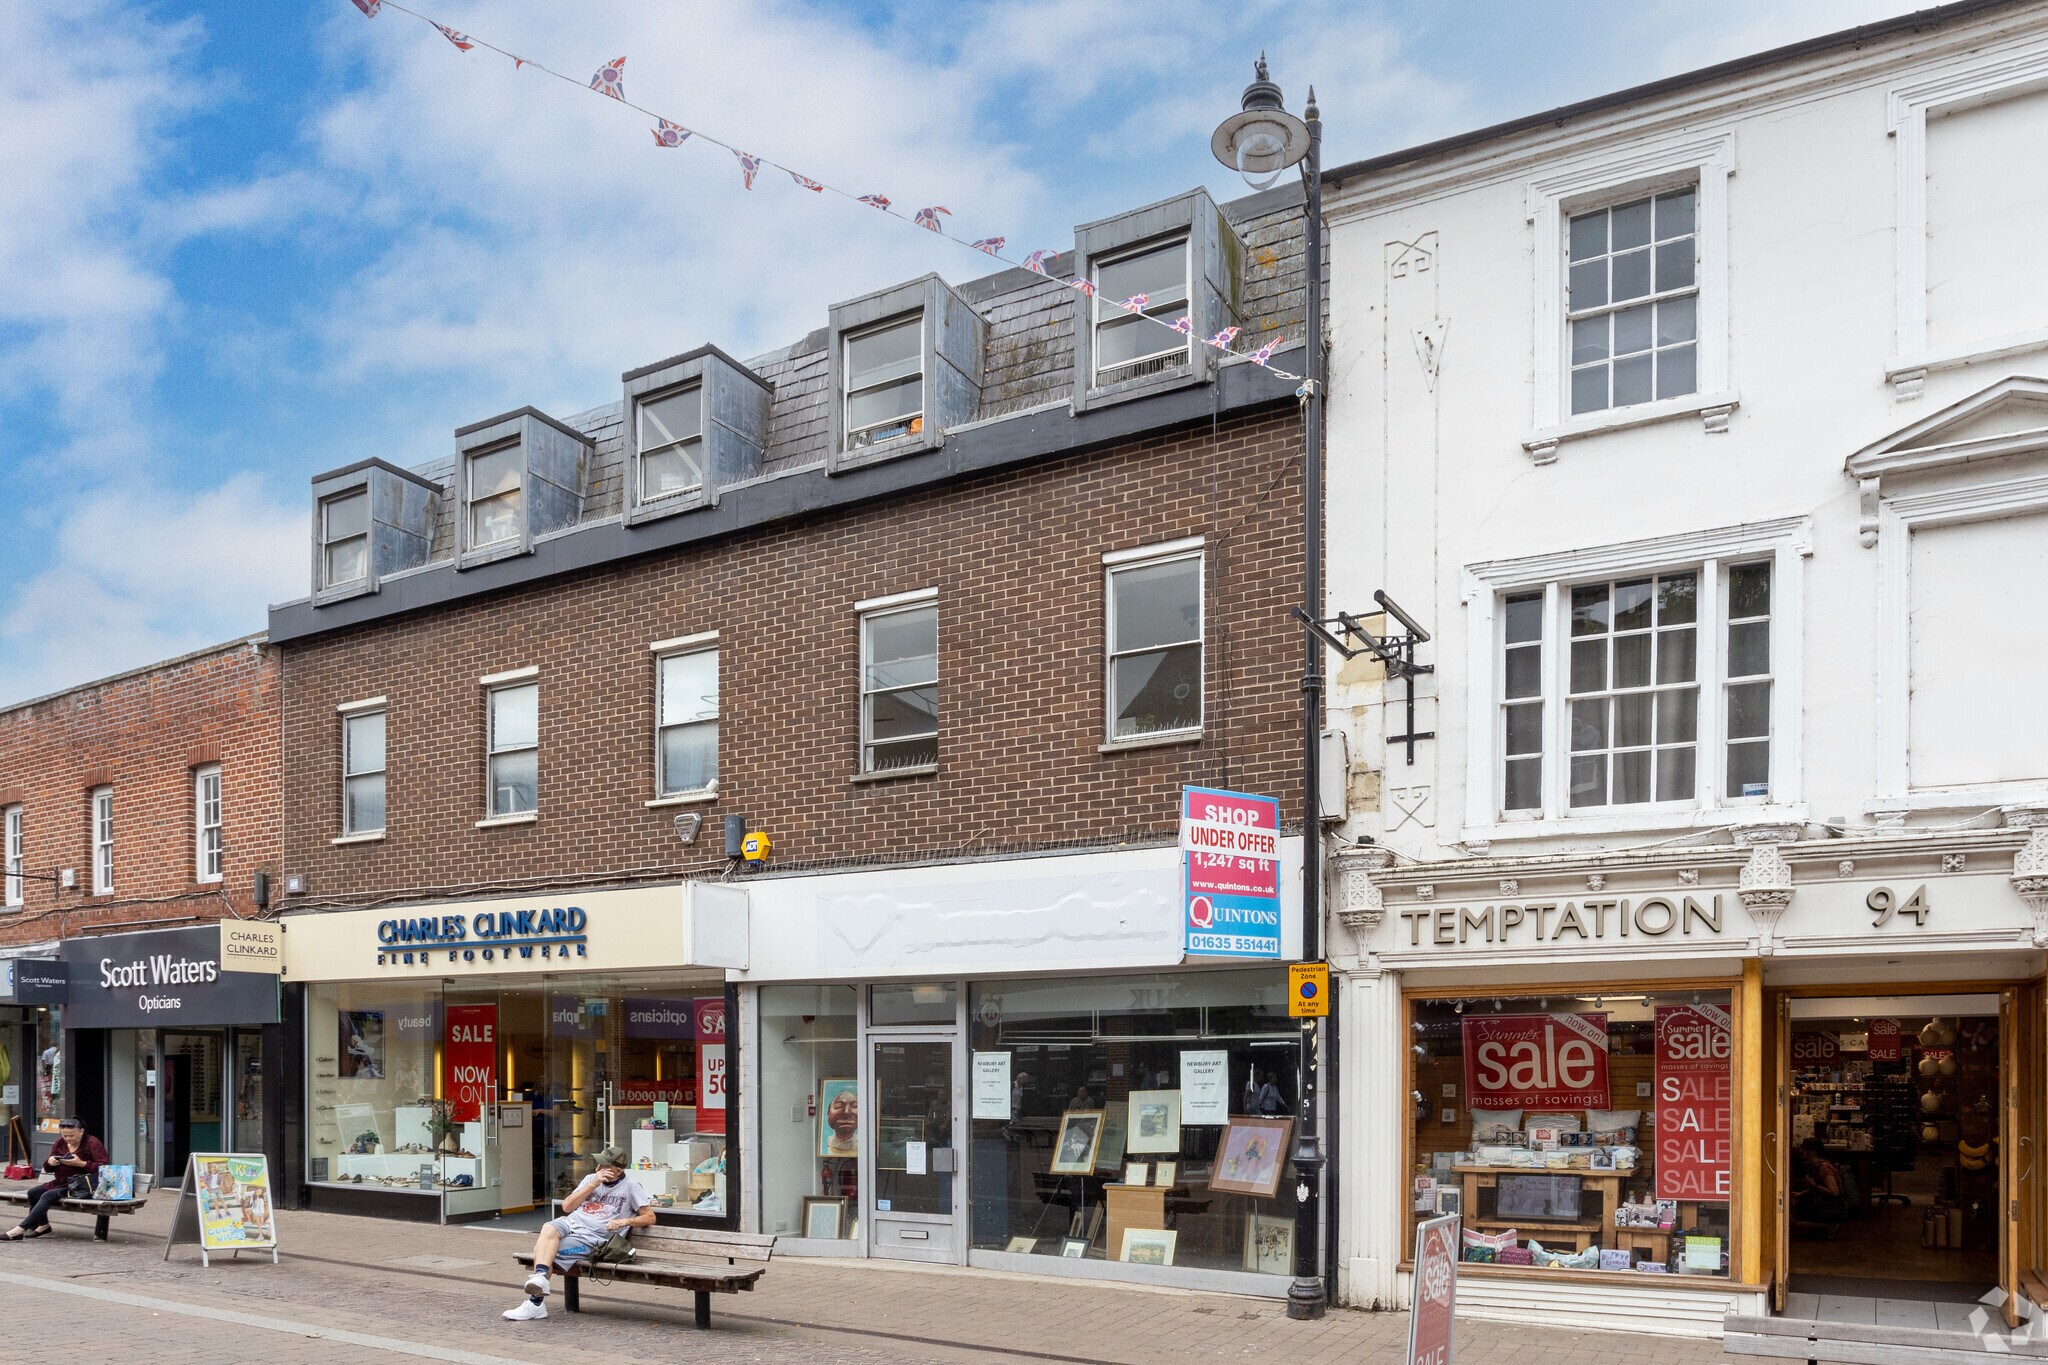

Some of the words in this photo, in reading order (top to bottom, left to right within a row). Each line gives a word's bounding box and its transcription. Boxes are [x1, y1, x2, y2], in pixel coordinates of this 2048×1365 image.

[1204, 804, 1260, 827] SHOP
[745, 841, 758, 852] ADT
[1190, 826, 1235, 850] UNDER
[1238, 831, 1276, 855] OFFER
[1194, 852, 1235, 870] 1,247
[1238, 859, 1256, 873] sq
[1258, 858, 1270, 872] ft
[1192, 879, 1275, 894] www.quintons.co.uk
[1190, 895, 1277, 929] QUINTONS
[1866, 884, 1930, 928] 94
[377, 914, 467, 944] CHARLES
[472, 906, 588, 938] CLINKARD
[1400, 894, 1722, 946] TEMPTATION
[230, 931, 274, 944] CHARLES
[1192, 935, 1232, 949] 01635
[1235, 938, 1276, 952] 551441
[226, 944, 278, 956] CLINKARD
[377, 949, 429, 965] FINE
[448, 943, 587, 962] FOOTWEAR
[100, 957, 148, 989] Scott
[150, 954, 217, 985] Waters
[1291, 965, 1327, 974] Pedestrian
[1300, 972, 1317, 980] Zone
[41, 977, 66, 985] Waters
[138, 994, 181, 1013] Opticians
[1298, 1000, 1306, 1008] At
[1307, 1001, 1320, 1009] any
[1700, 1005, 1721, 1021] now
[452, 1024, 493, 1043] SALE
[1476, 1022, 1542, 1042] Summer
[1565, 1014, 1587, 1031] now
[1587, 1027, 1606, 1044] on!
[1667, 1024, 1705, 1034] Summer
[1873, 1022, 1897, 1036] sale
[1668, 1024, 1731, 1060] sale
[1794, 1038, 1835, 1059] sale
[1477, 1024, 1596, 1091] sale
[1870, 1049, 1897, 1059] SALE
[454, 1065, 490, 1084] NOW
[708, 1058, 725, 1072] UP
[460, 1085, 482, 1103] ON
[1662, 1077, 1730, 1102] SALE
[1471, 1094, 1520, 1106] masses
[1525, 1094, 1540, 1105] of
[1544, 1093, 1604, 1107] savings!
[1662, 1107, 1730, 1133] SALE
[1662, 1138, 1730, 1164] SALE
[235, 1163, 257, 1179] Kids
[1663, 1169, 1730, 1195] SALE
[1687, 1237, 1720, 1246] WINNER
[1424, 1261, 1450, 1303] sale
